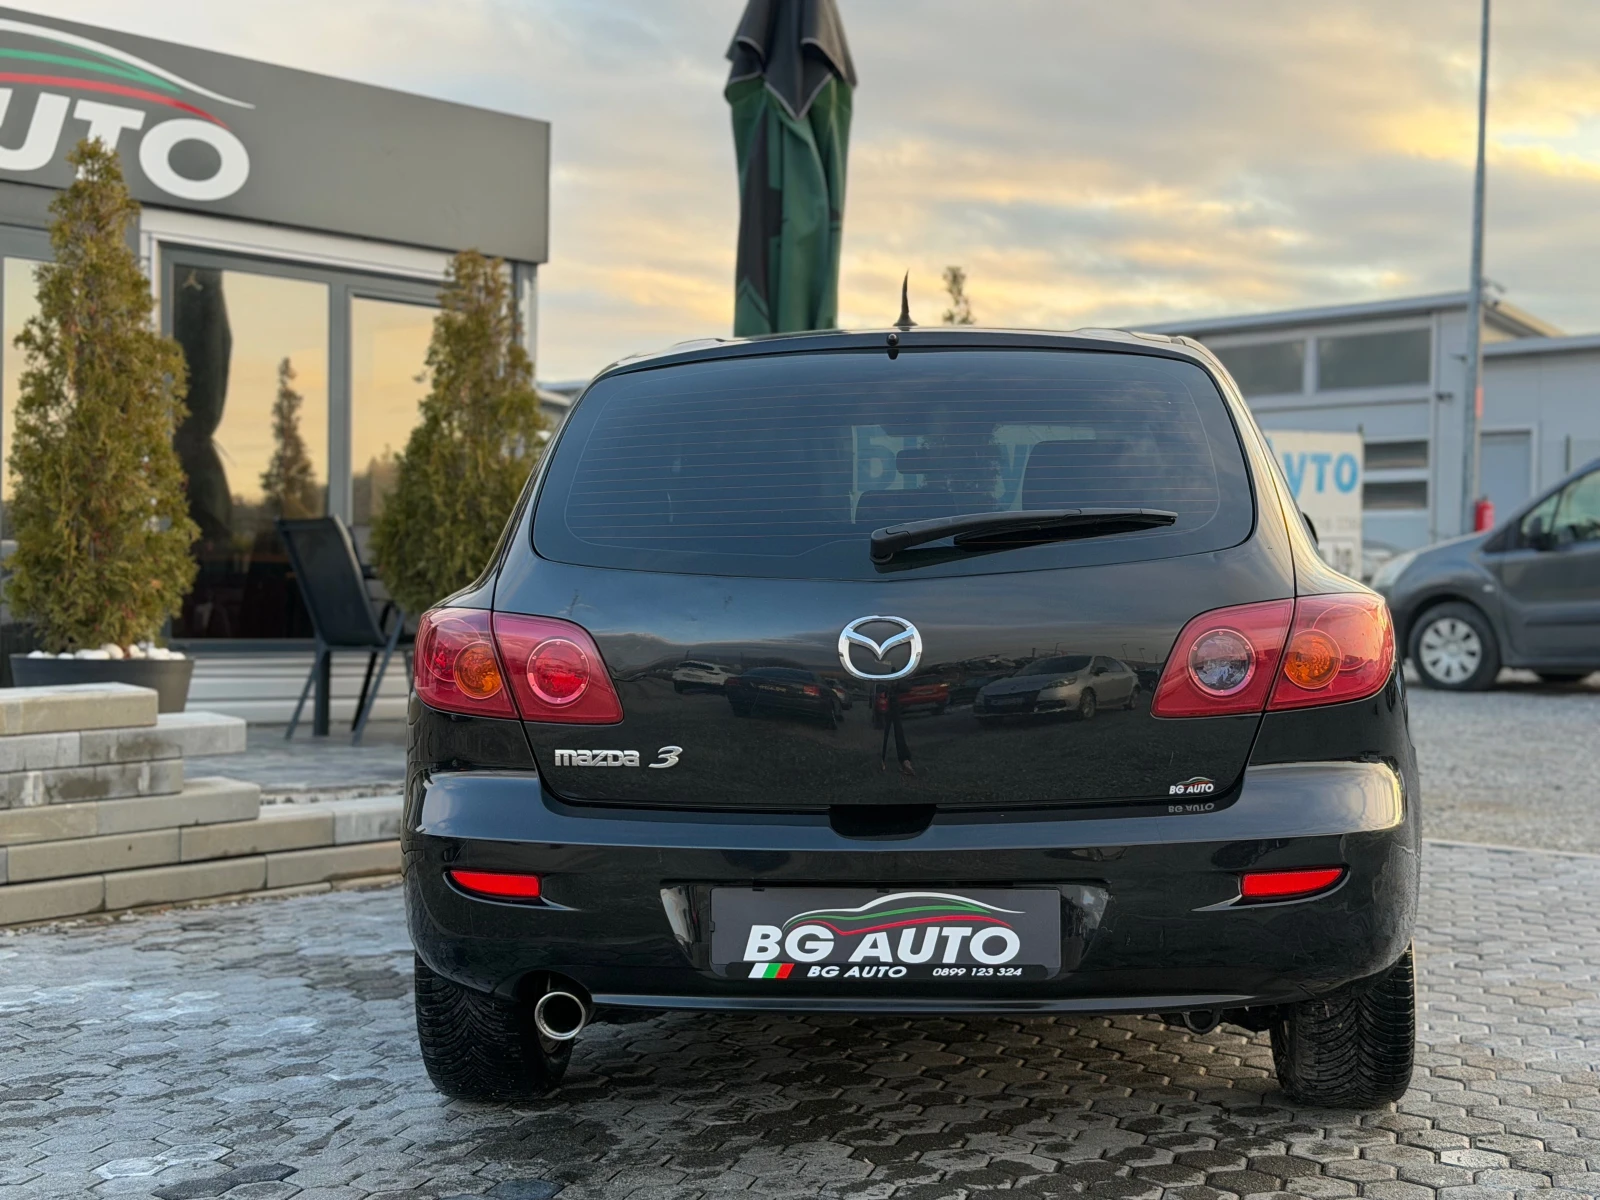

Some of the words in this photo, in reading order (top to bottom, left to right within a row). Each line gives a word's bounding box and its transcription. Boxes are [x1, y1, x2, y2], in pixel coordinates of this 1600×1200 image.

[648, 745, 683, 769] 3
[1169, 785, 1184, 795] BG
[1186, 783, 1214, 793] AUTO
[742, 924, 835, 963] BG
[847, 926, 1021, 964] AUTO
[806, 965, 840, 978] BG
[843, 965, 908, 978] AUTO
[932, 967, 967, 977] 0899
[971, 967, 994, 977] 123
[996, 967, 1023, 977] 324
